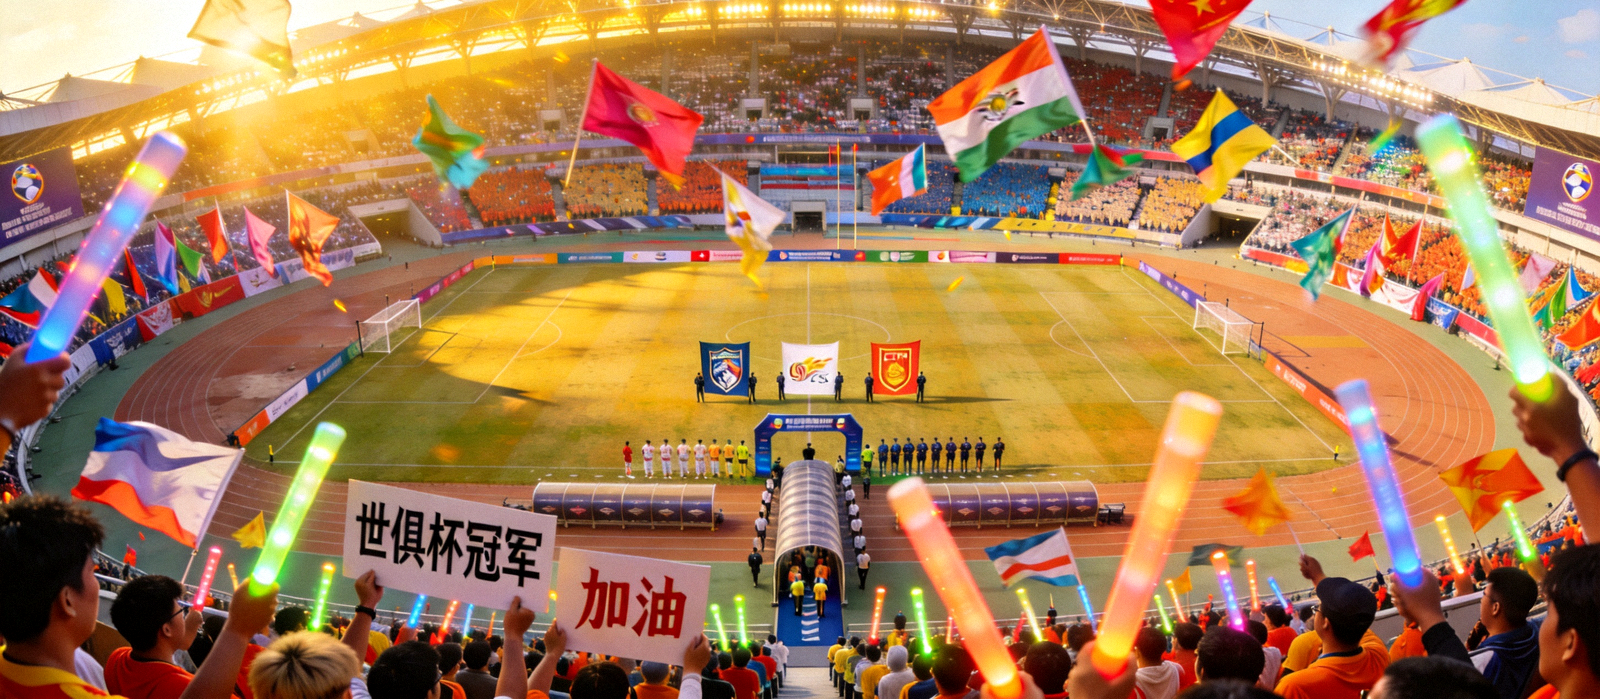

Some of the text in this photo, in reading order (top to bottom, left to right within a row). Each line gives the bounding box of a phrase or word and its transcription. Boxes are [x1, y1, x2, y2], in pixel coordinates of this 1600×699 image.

[356, 501, 543, 587] 世俱杯冠军
[575, 566, 687, 639] 加油
